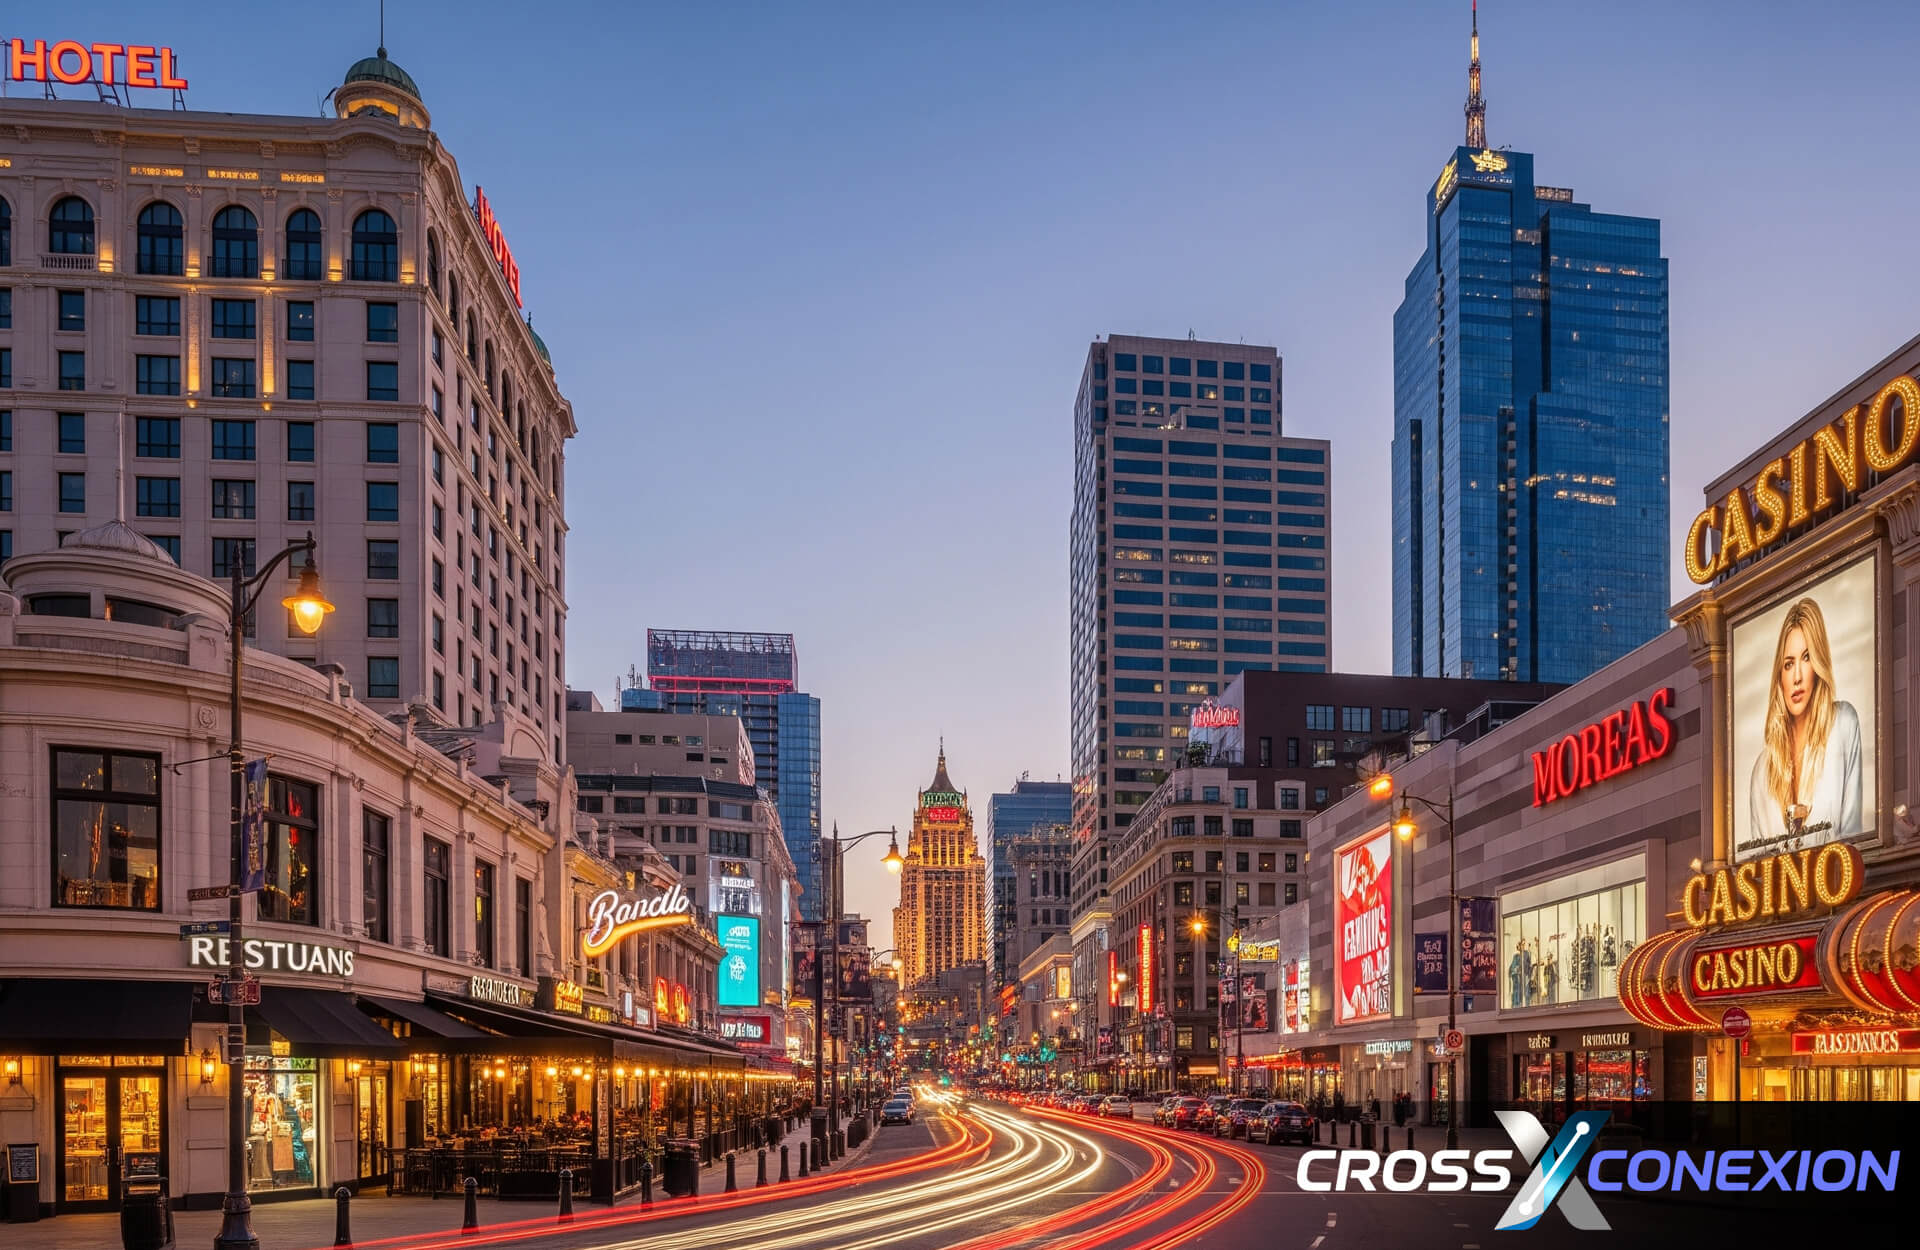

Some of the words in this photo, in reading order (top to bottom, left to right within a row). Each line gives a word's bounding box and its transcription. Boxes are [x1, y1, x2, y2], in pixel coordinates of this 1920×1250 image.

[11, 38, 188, 90] HOTEL
[1685, 374, 1920, 585] CASINO
[1531, 687, 1677, 809] MOREAS
[1683, 843, 1856, 928] CASINO
[1695, 943, 1799, 992] CASINO
